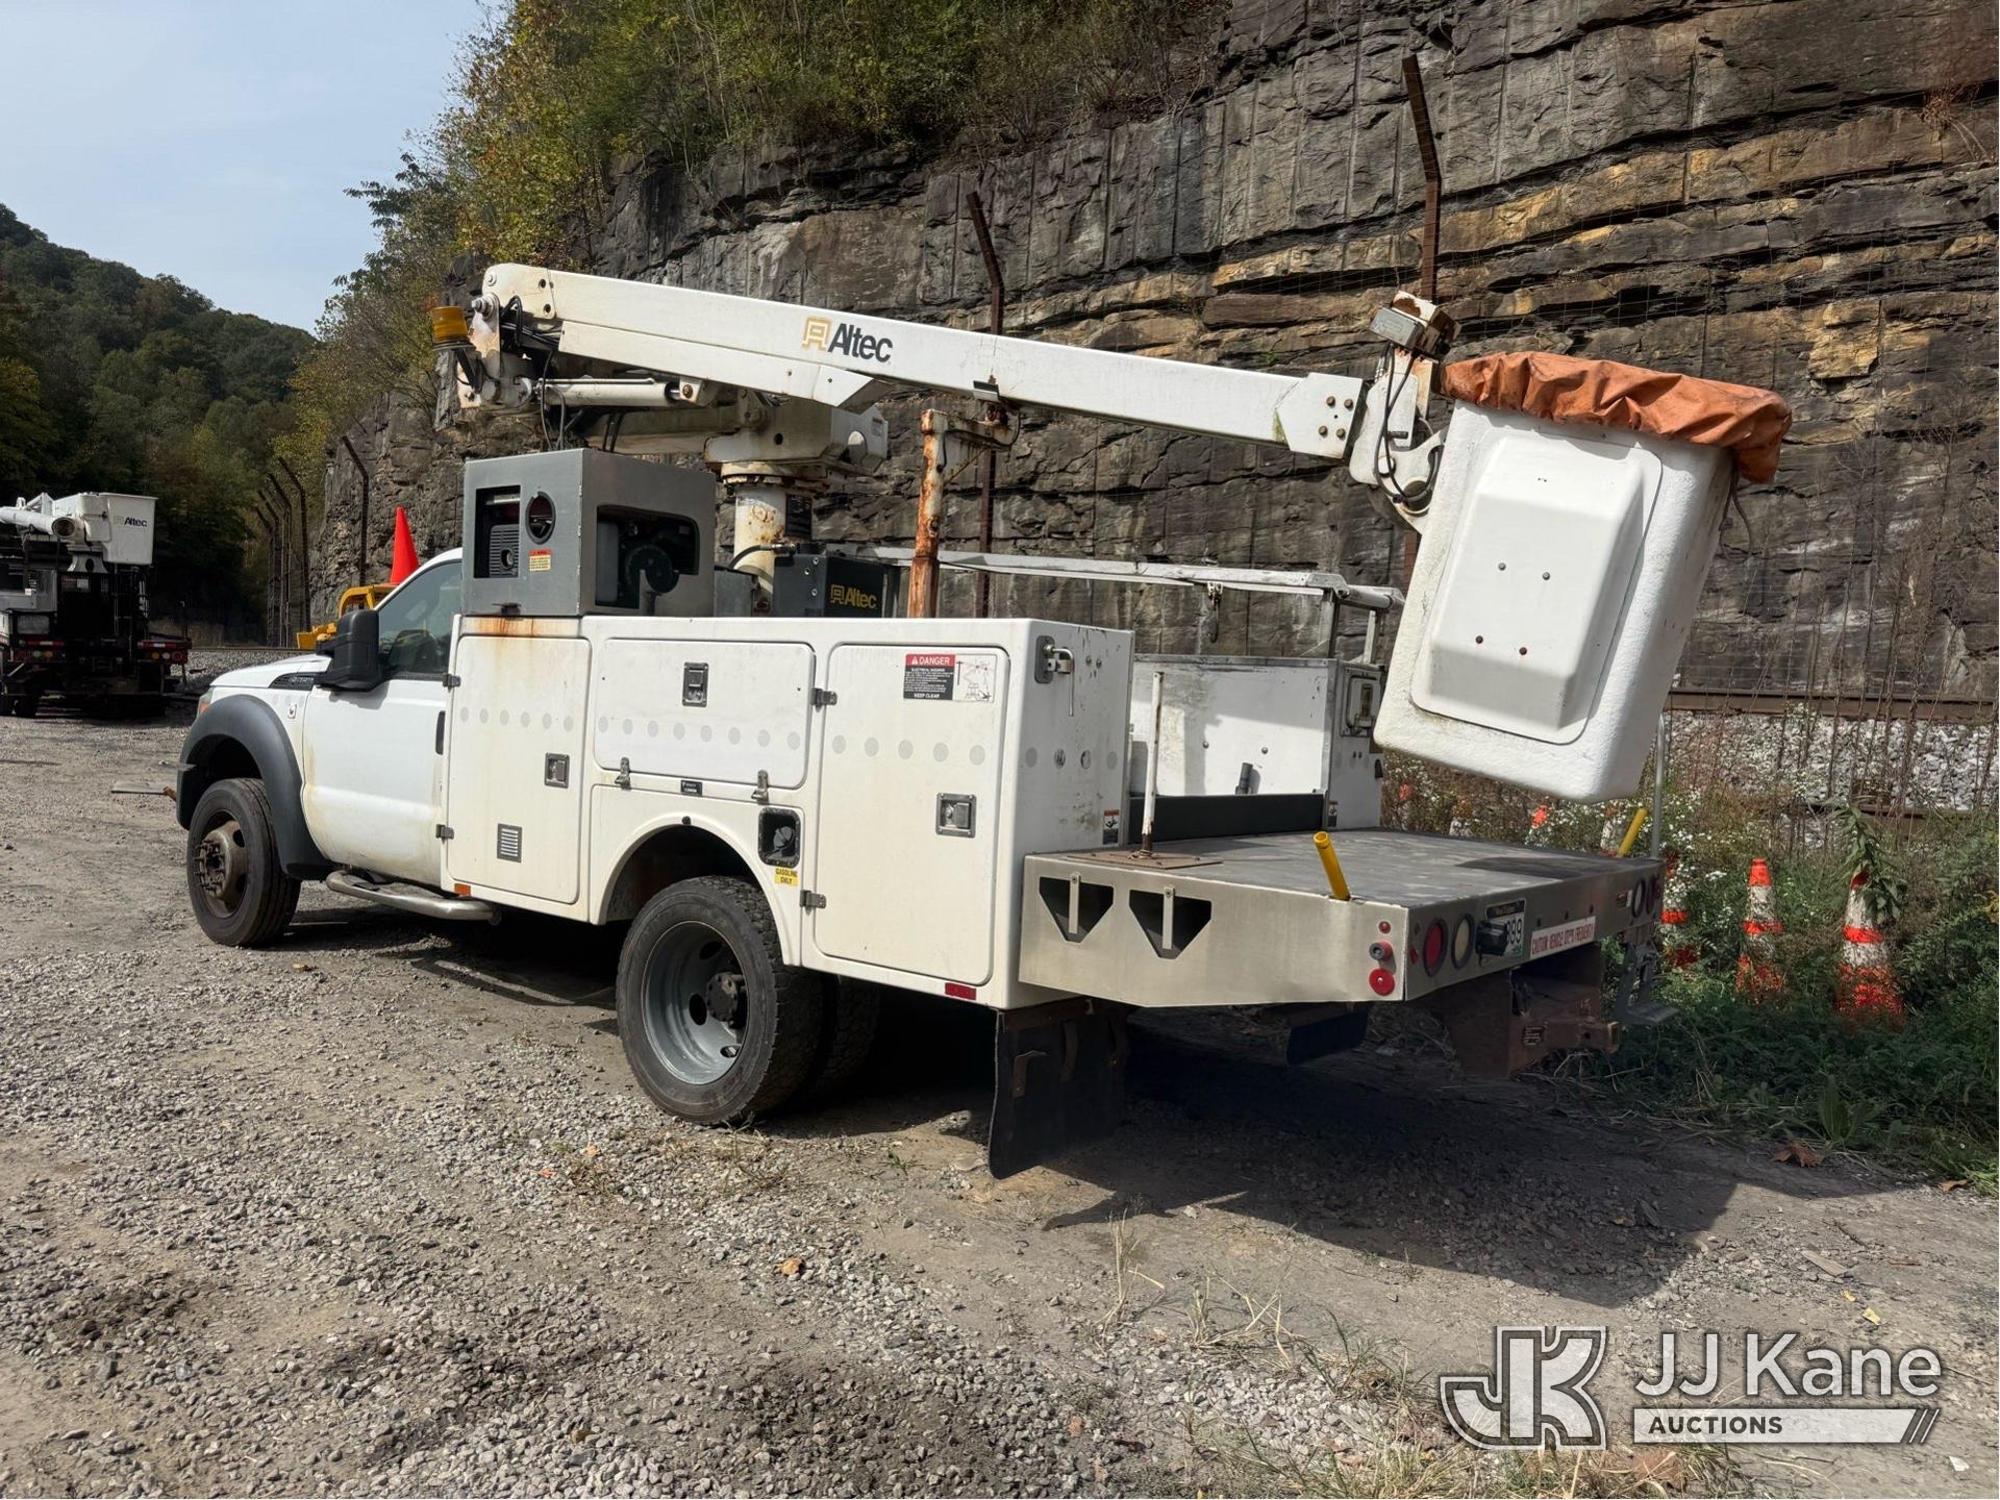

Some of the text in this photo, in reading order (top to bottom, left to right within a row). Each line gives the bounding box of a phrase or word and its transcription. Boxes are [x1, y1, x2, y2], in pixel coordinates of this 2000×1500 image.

[827, 323, 893, 363] Altec
[124, 516, 148, 527] Altec
[844, 587, 877, 609] Altec
[919, 656, 951, 665] DANGER
